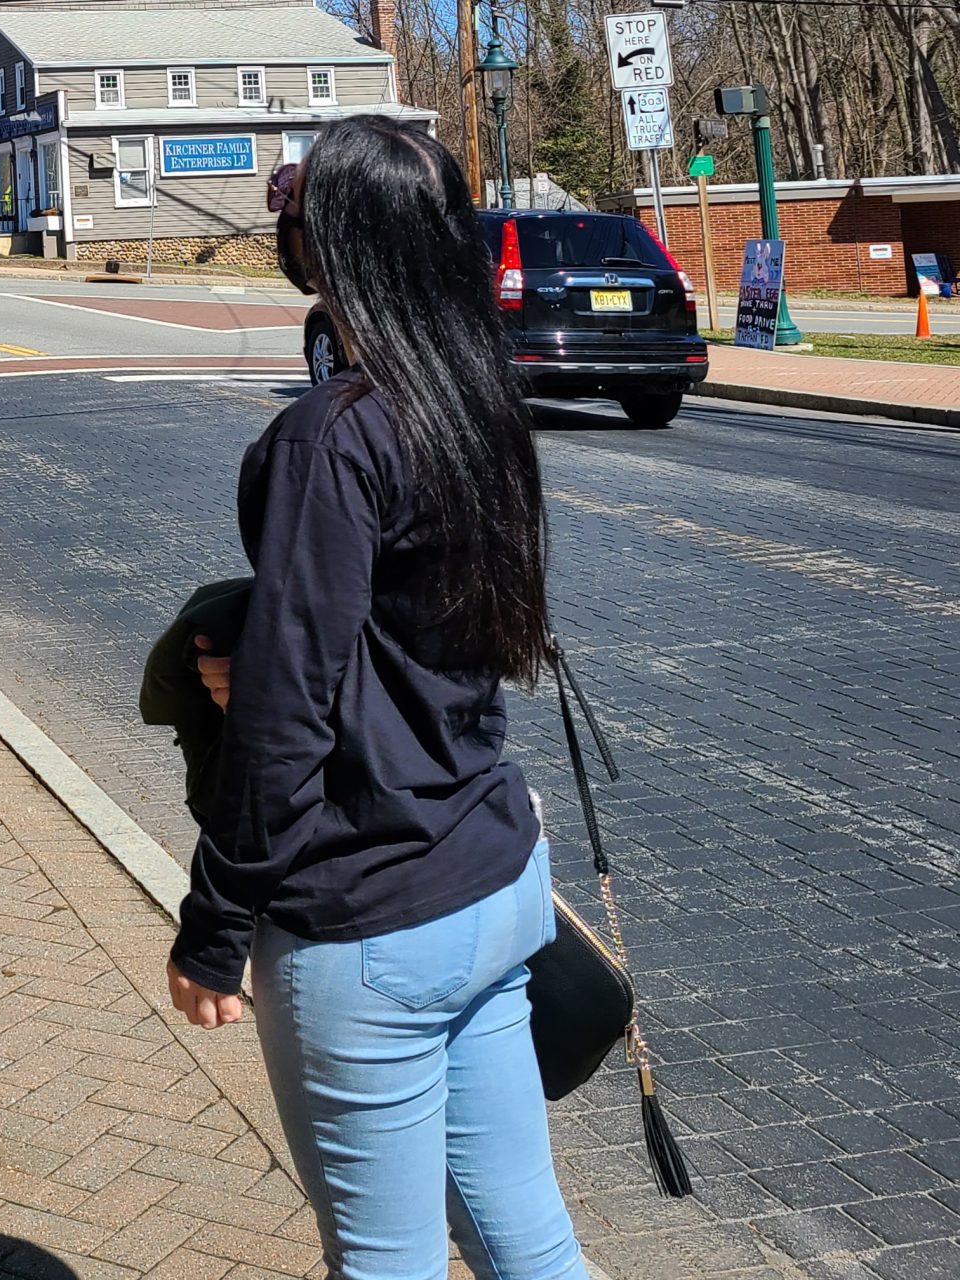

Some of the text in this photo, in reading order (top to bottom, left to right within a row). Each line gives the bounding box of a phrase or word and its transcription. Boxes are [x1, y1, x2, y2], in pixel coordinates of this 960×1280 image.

[615, 19, 657, 35] STOP
[624, 36, 650, 46] HERE
[639, 56, 653, 65] ON
[633, 66, 665, 82] RED
[640, 97, 662, 107] 303
[638, 115, 658, 124] ALL
[634, 124, 664, 135] TRUCK
[632, 133, 670, 145] TRAFFIC
[165, 142, 251, 156] KIRCHNER FAMILY
[171, 154, 247, 169] ENTERPRISES LP
[755, 299, 773, 310] THRU
[738, 313, 775, 330] FOOD DRIVE
